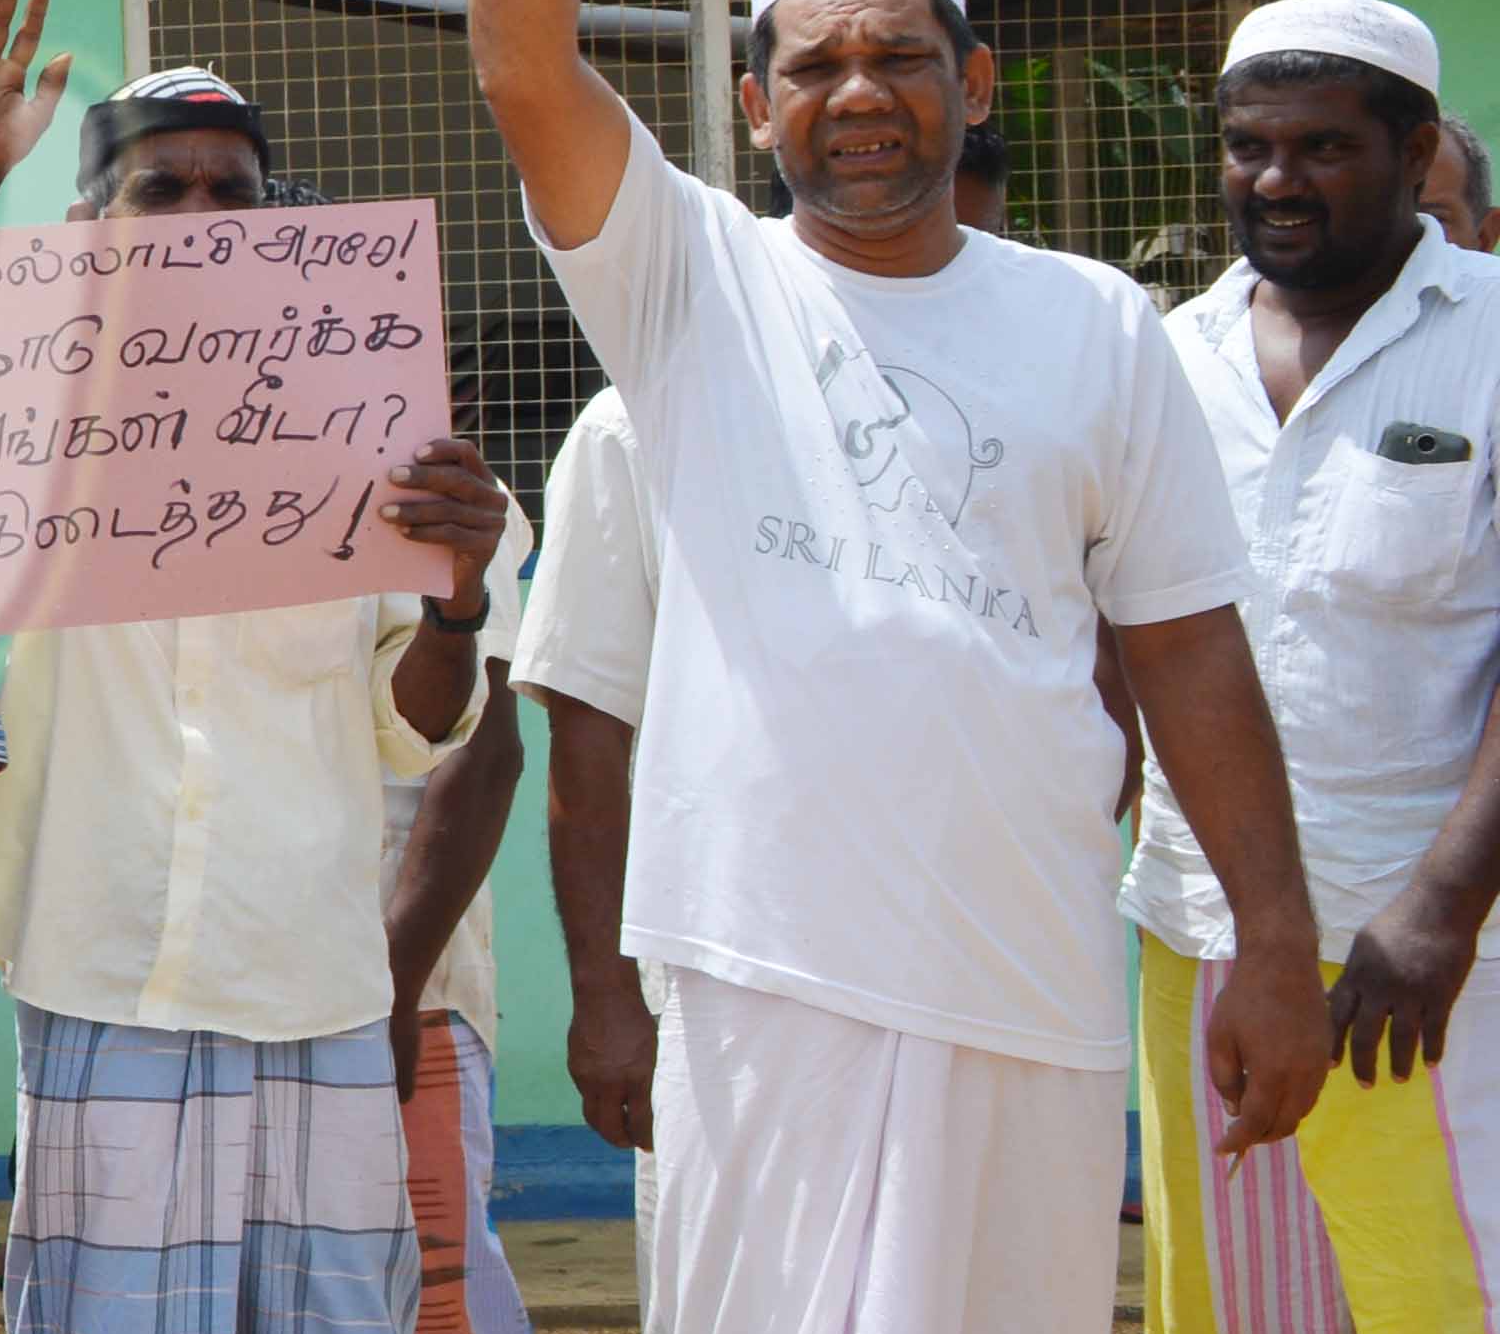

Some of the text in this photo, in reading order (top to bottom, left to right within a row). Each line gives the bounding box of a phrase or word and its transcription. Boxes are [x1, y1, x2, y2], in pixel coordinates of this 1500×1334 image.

[253, 217, 418, 283] அரசே!
[753, 513, 1042, 641] SRI LANKA
